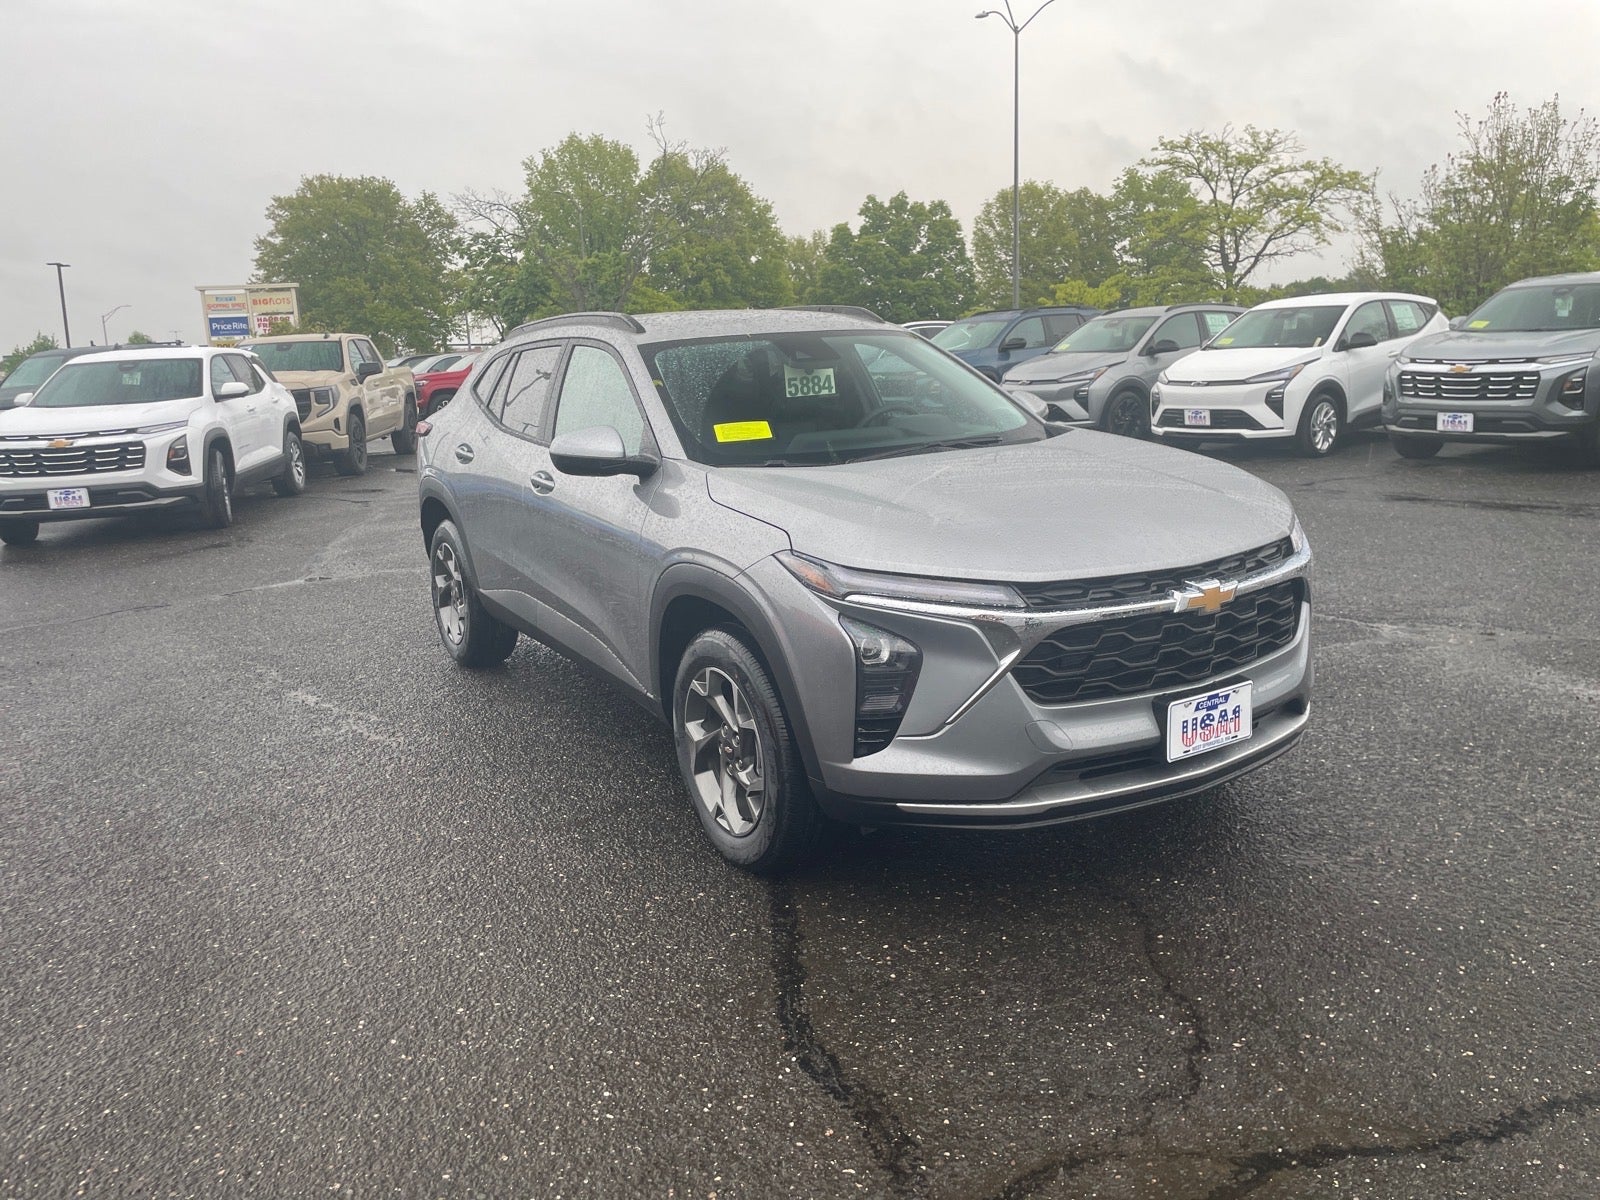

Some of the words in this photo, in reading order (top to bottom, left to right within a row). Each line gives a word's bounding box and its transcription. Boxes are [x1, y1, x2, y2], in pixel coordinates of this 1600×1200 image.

[212, 322, 232, 331] Price
[232, 321, 248, 330] Rite
[787, 374, 834, 397] 5884
[1198, 697, 1227, 709] CENTRAL
